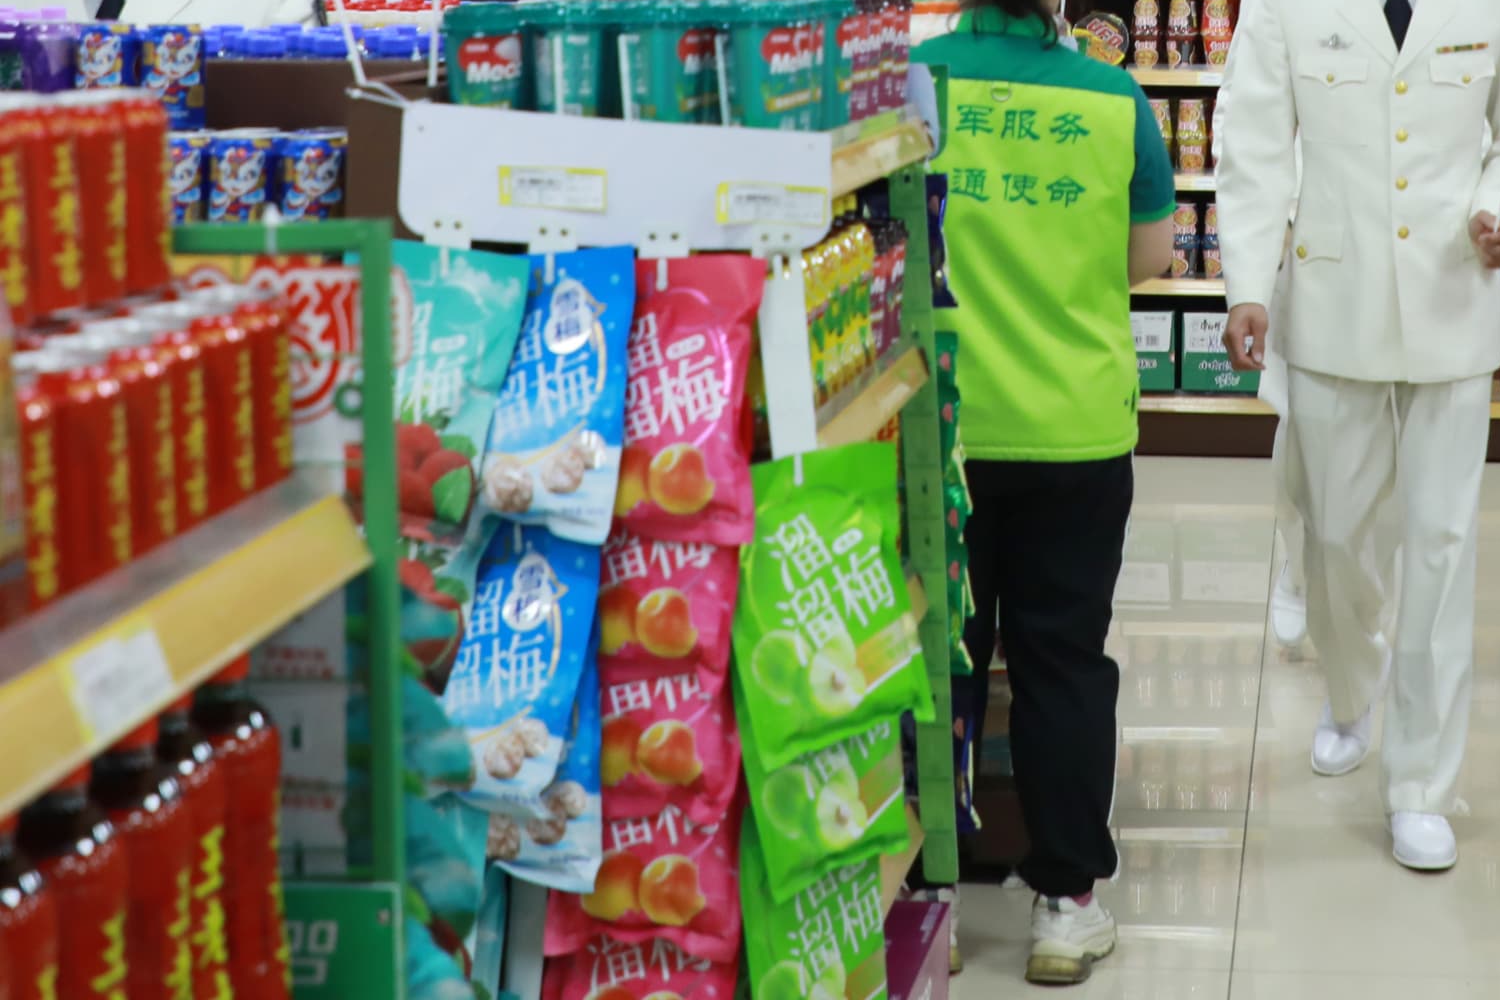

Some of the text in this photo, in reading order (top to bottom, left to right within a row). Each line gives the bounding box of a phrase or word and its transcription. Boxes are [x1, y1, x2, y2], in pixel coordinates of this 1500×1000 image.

[955, 104, 1091, 145] 军服务
[949, 166, 1086, 209] 通使命
